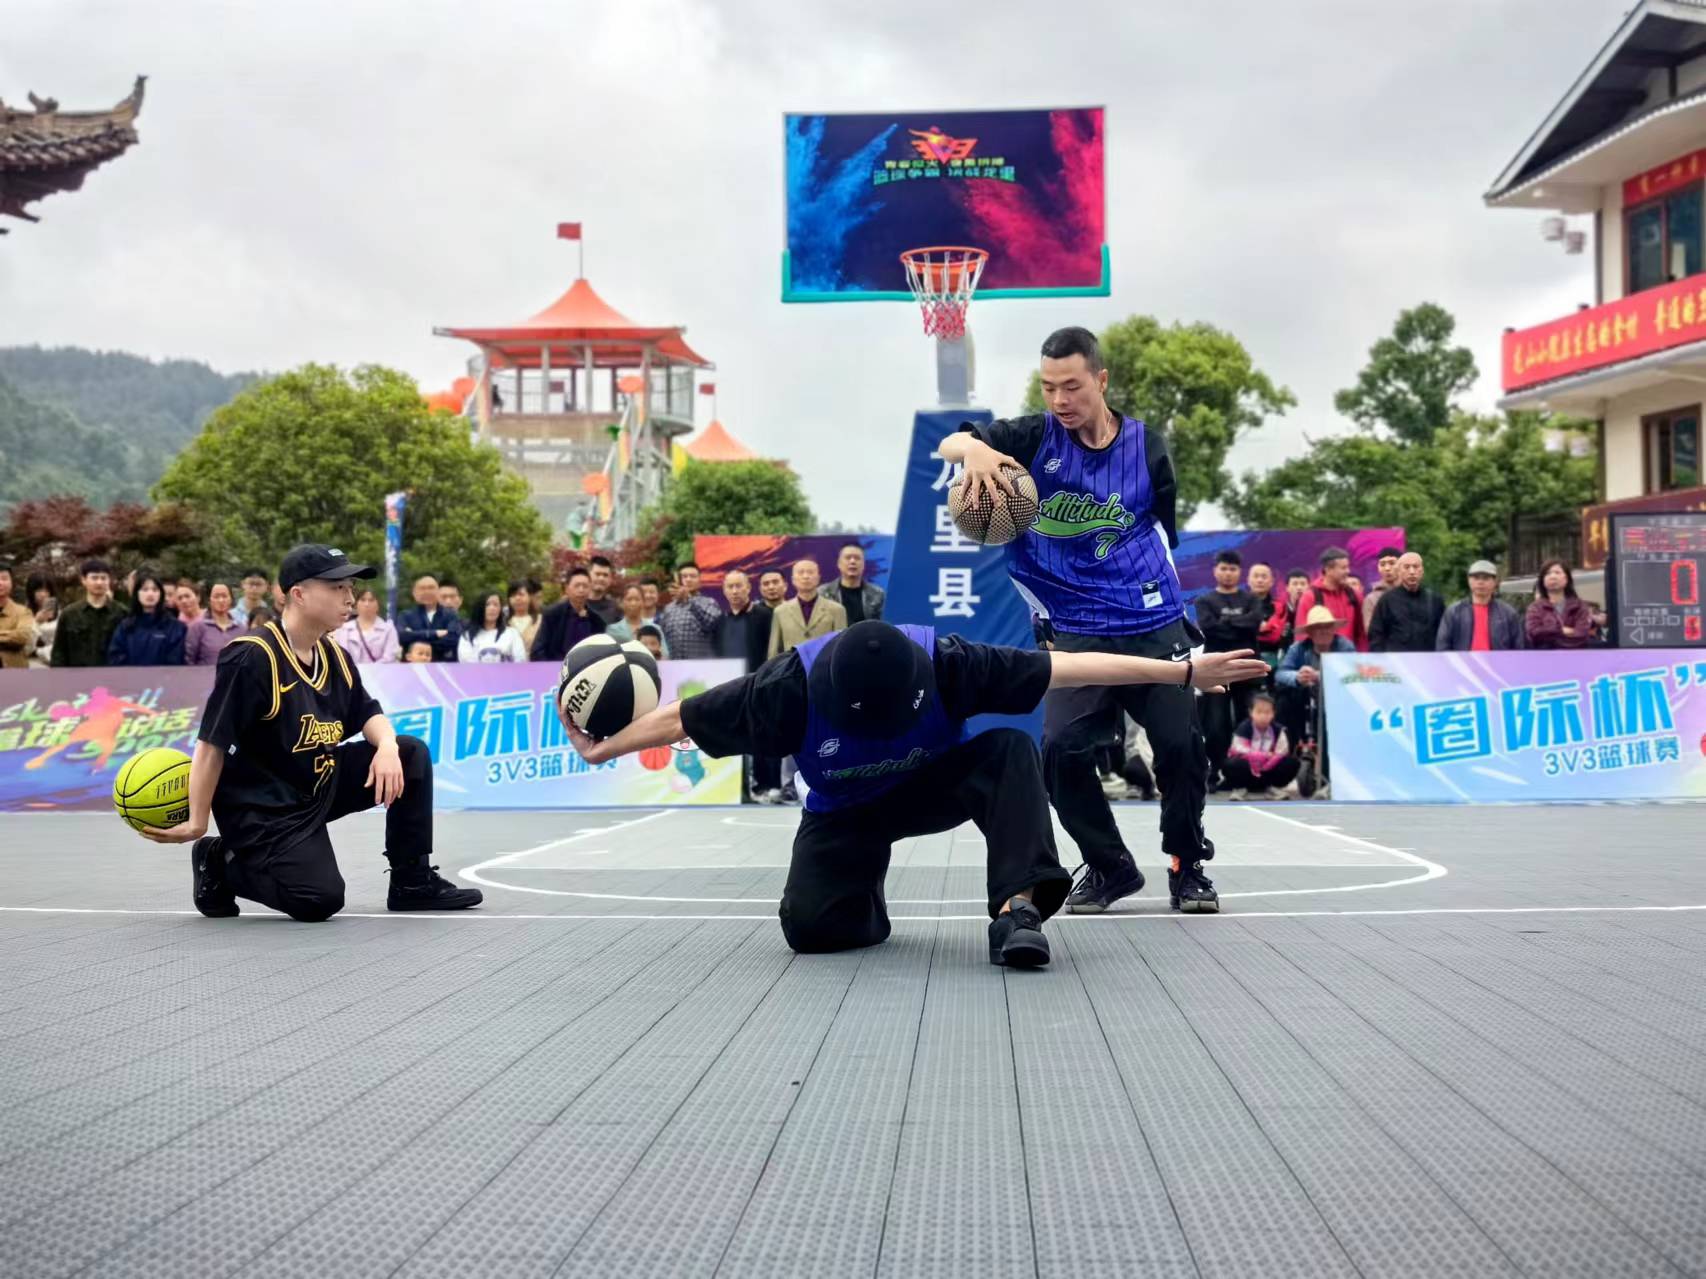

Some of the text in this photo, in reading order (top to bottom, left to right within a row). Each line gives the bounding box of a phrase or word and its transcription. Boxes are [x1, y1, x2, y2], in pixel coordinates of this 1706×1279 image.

[1040, 490, 1126, 523] Attitude
[1095, 531, 1120, 560] 7
[1670, 558, 1698, 606] 0
[1545, 736, 1681, 776] 3V3篮球赛
